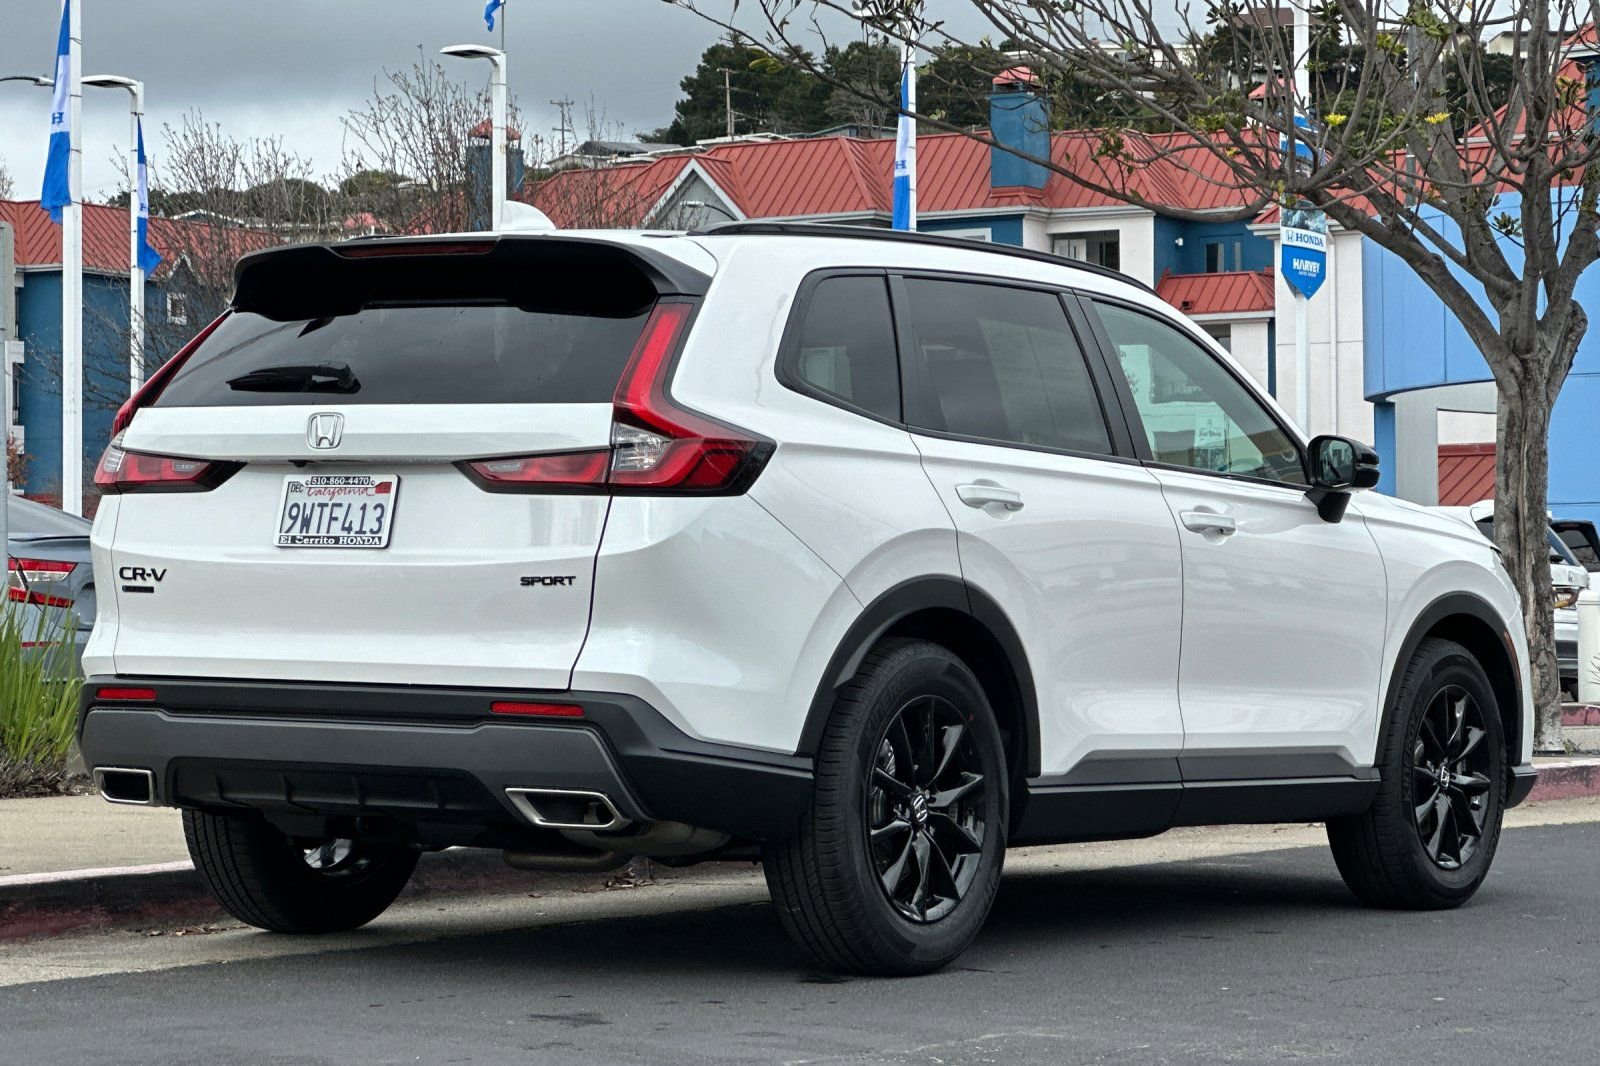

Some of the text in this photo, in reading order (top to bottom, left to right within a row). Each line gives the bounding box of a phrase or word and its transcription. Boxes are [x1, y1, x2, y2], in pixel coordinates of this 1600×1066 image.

[1295, 233, 1323, 247] HONDA
[312, 476, 369, 486] 510-860-4470
[290, 483, 304, 493] DEC
[284, 502, 385, 535] 9WTF413
[279, 535, 380, 546] El Cerrito HONDA
[118, 566, 168, 583] CR-V
[519, 575, 577, 587] SPORT
